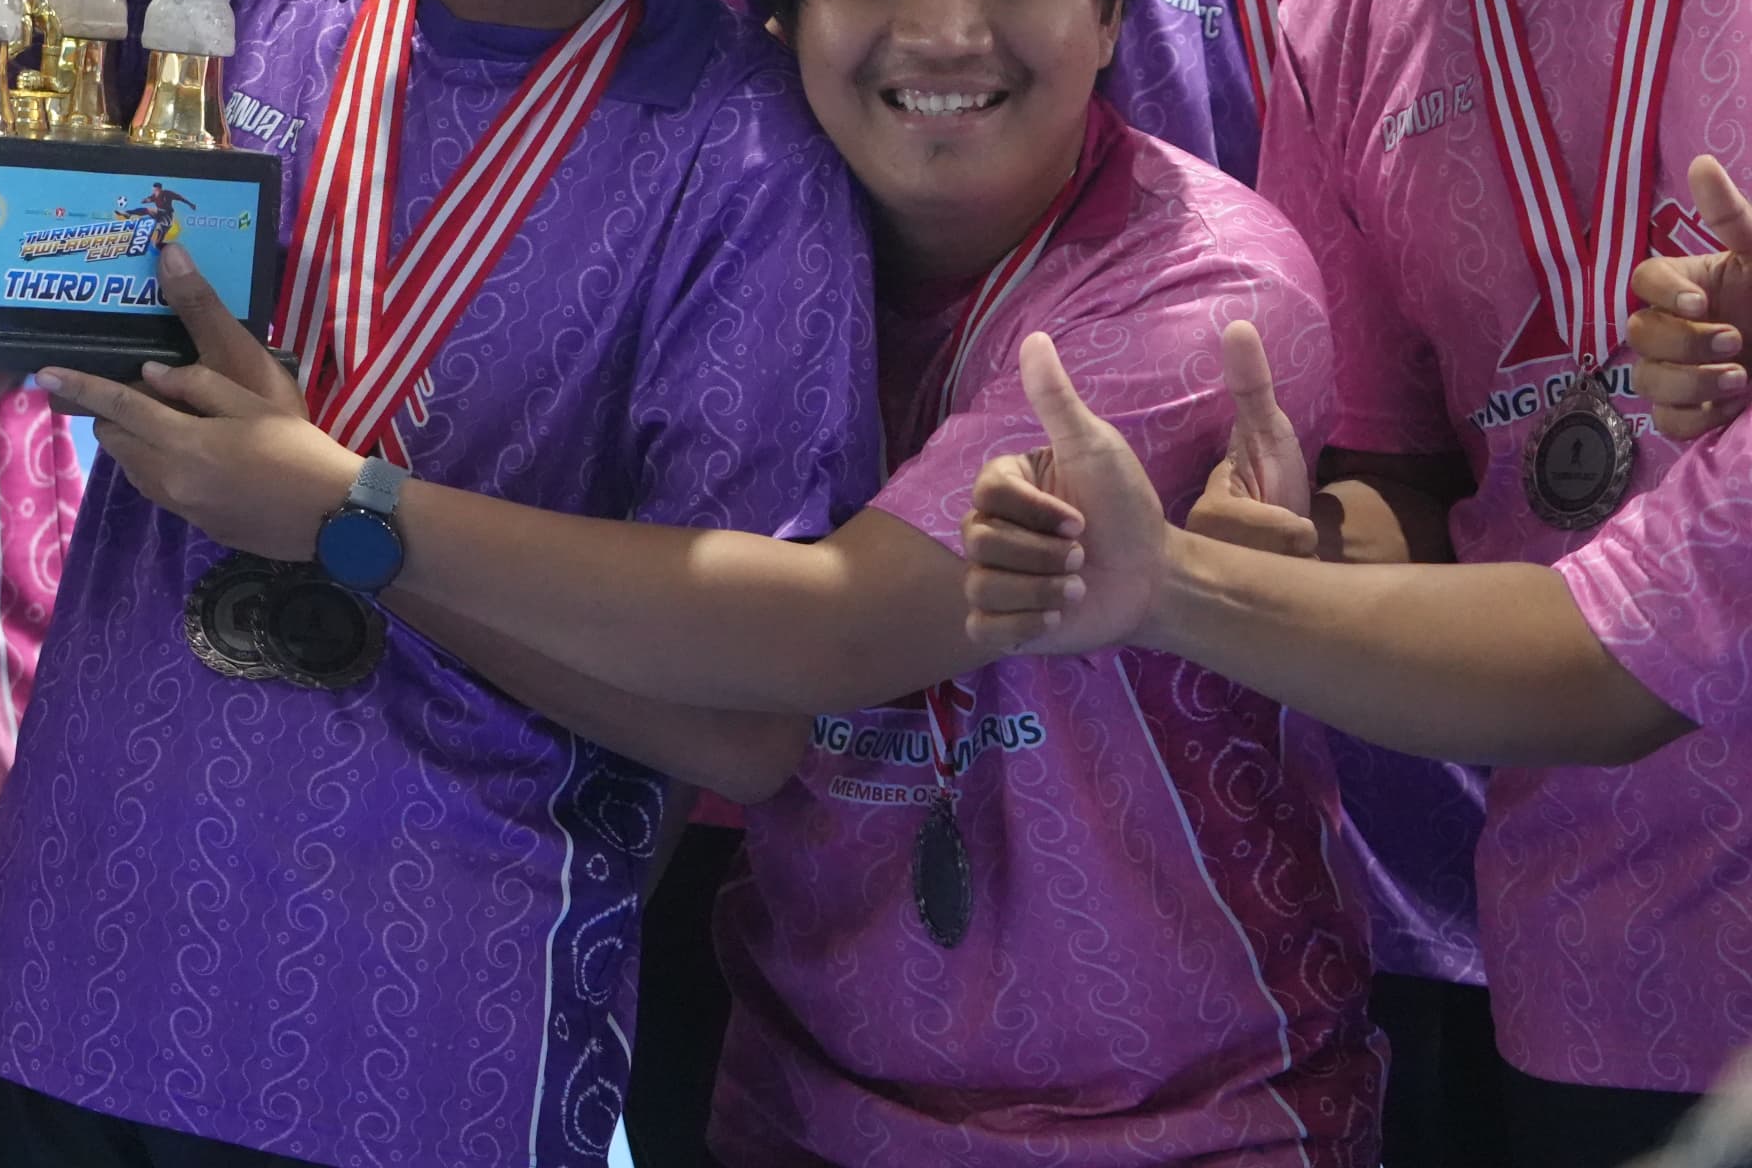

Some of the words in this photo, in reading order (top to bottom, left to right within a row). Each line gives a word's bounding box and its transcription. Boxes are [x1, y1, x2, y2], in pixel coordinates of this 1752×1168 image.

[226, 91, 284, 141] ANUA
[24, 219, 136, 244] TURNAMEN
[186, 215, 238, 229] adaro
[130, 218, 155, 255] 2025
[86, 244, 128, 262] CUP
[5, 269, 99, 304] THIRD
[831, 780, 906, 803] MEMBER
